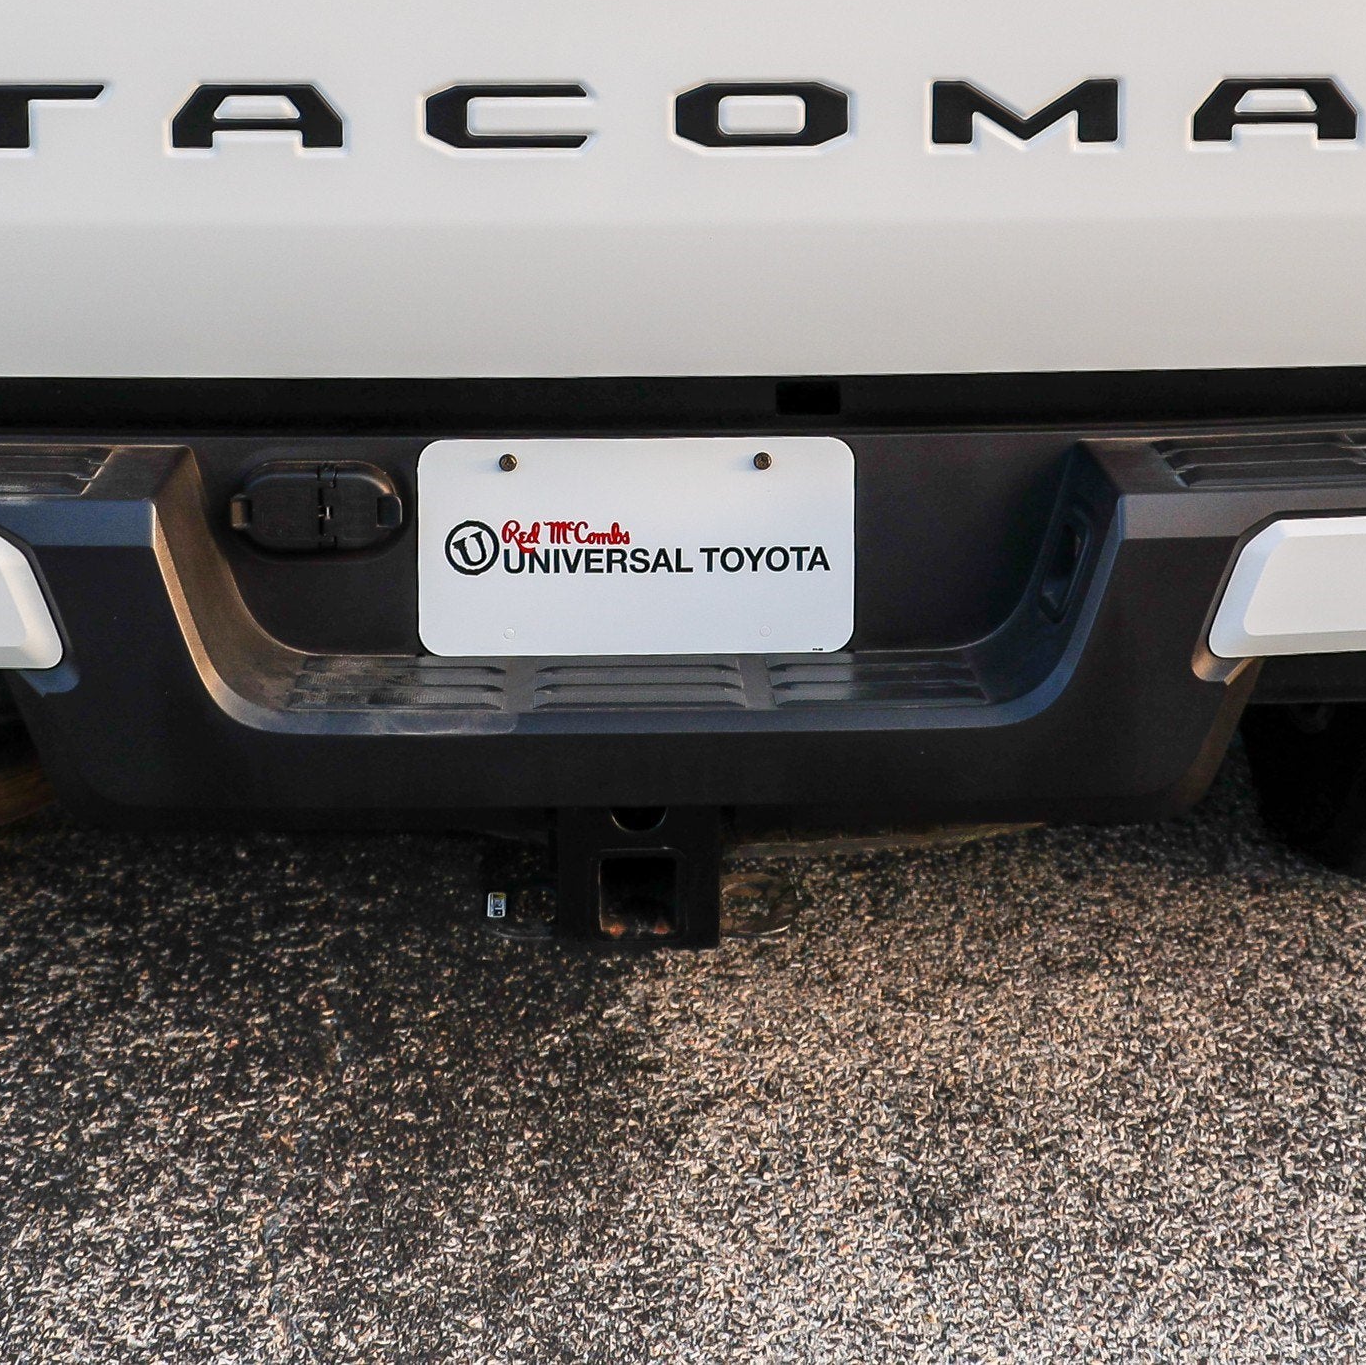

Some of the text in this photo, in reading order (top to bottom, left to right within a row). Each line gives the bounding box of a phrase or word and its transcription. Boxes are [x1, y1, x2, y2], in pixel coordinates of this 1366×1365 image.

[501, 519, 631, 554] Red McCombs
[503, 546, 831, 574] UNIVERSAL TOYOTA
